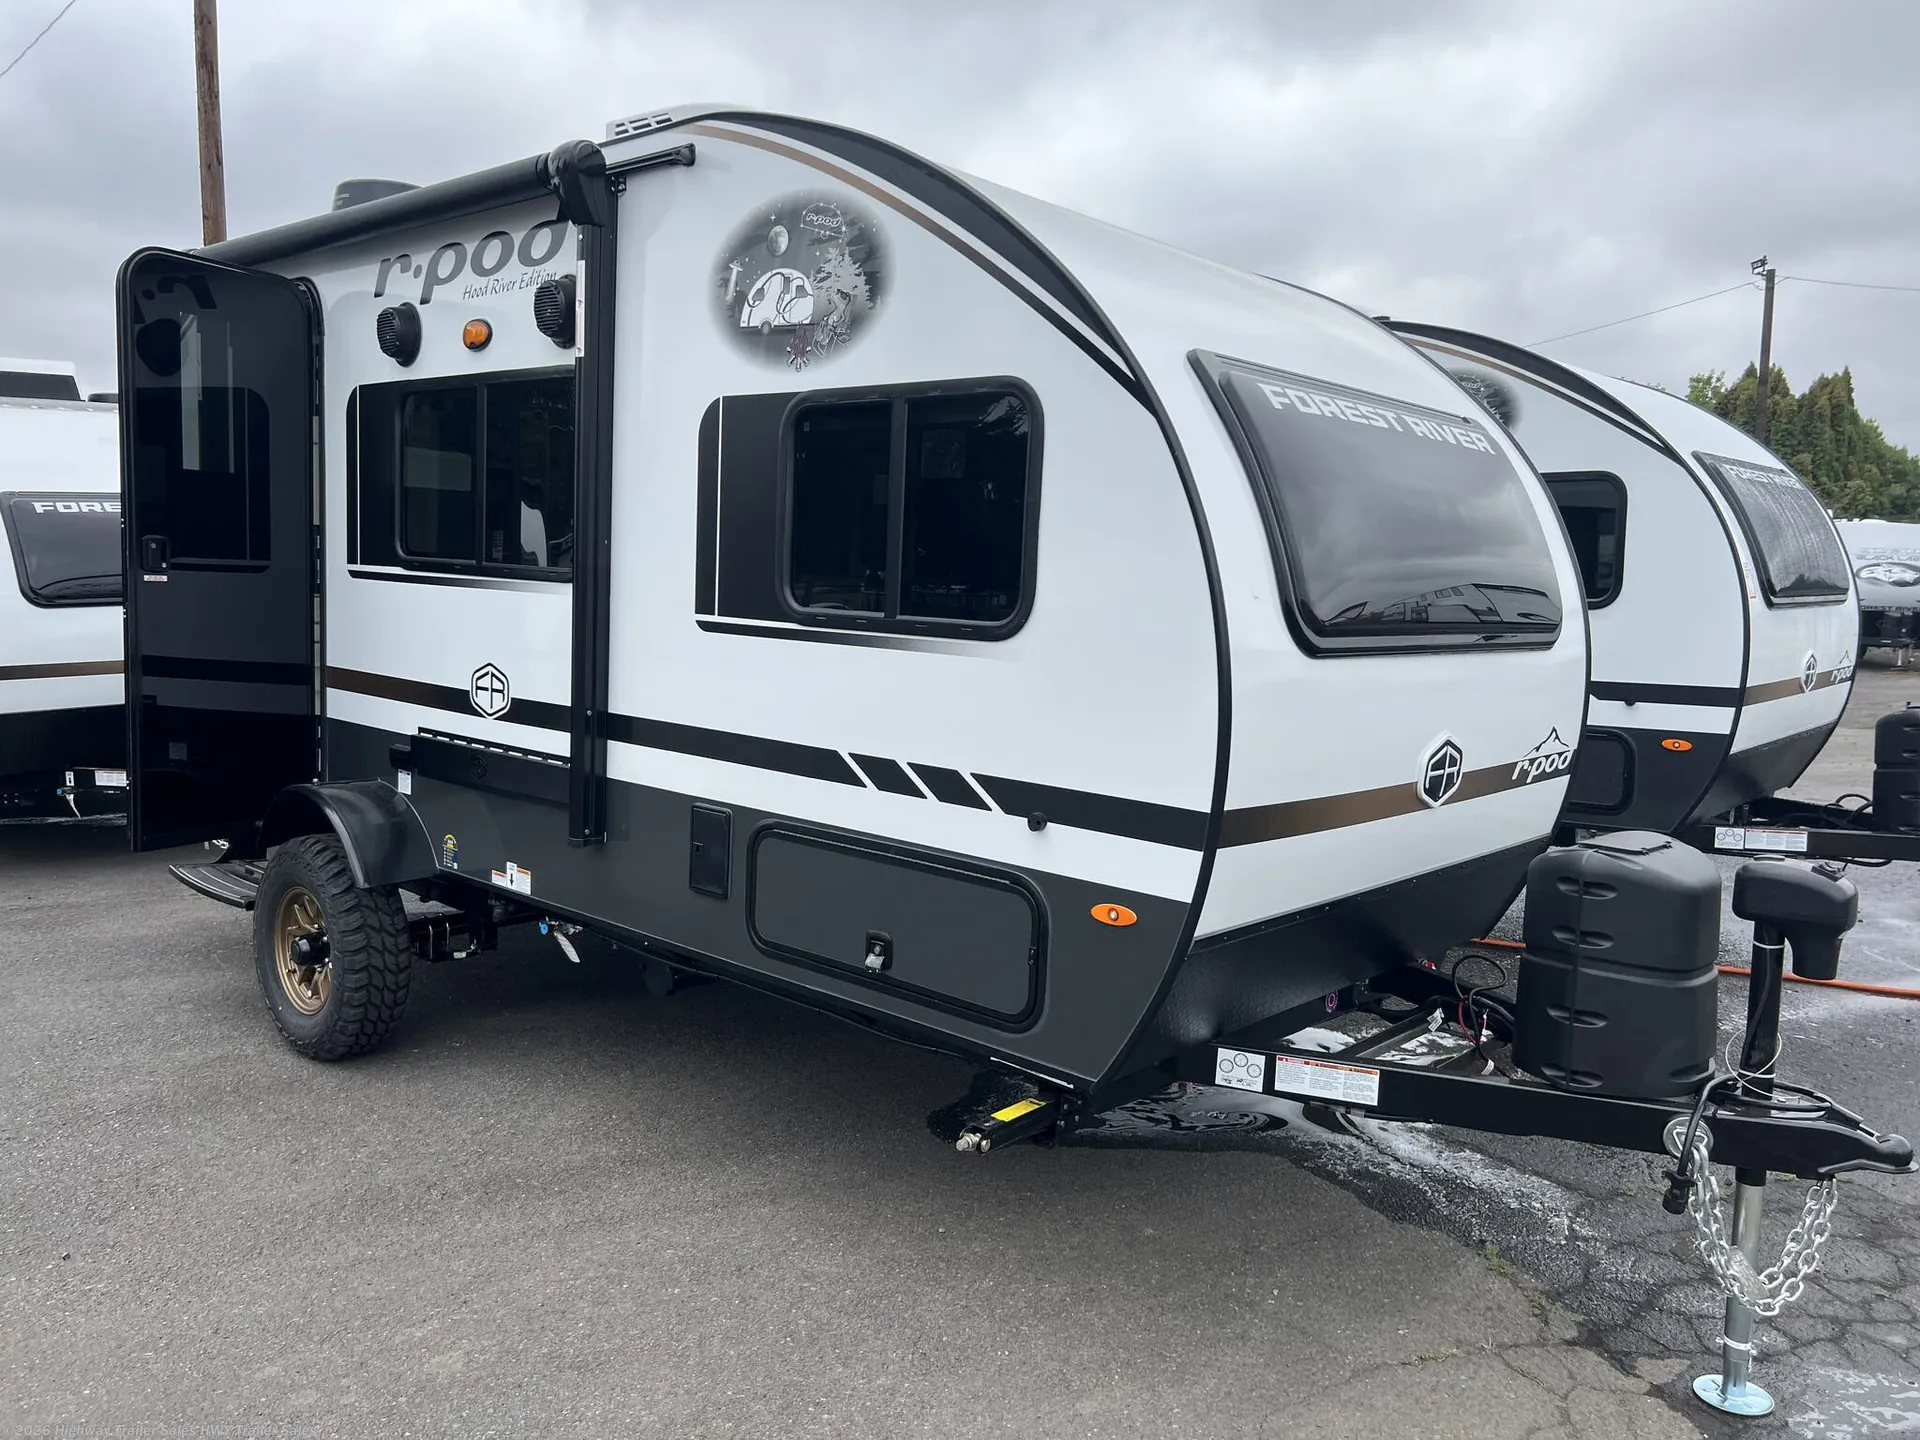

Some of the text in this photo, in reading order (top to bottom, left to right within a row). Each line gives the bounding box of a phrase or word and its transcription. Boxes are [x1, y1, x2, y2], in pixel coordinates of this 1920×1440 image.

[462, 268, 558, 300] Hood River Edition
[1257, 382, 1497, 455] FOREST RIVER
[31, 502, 121, 513] FORE
